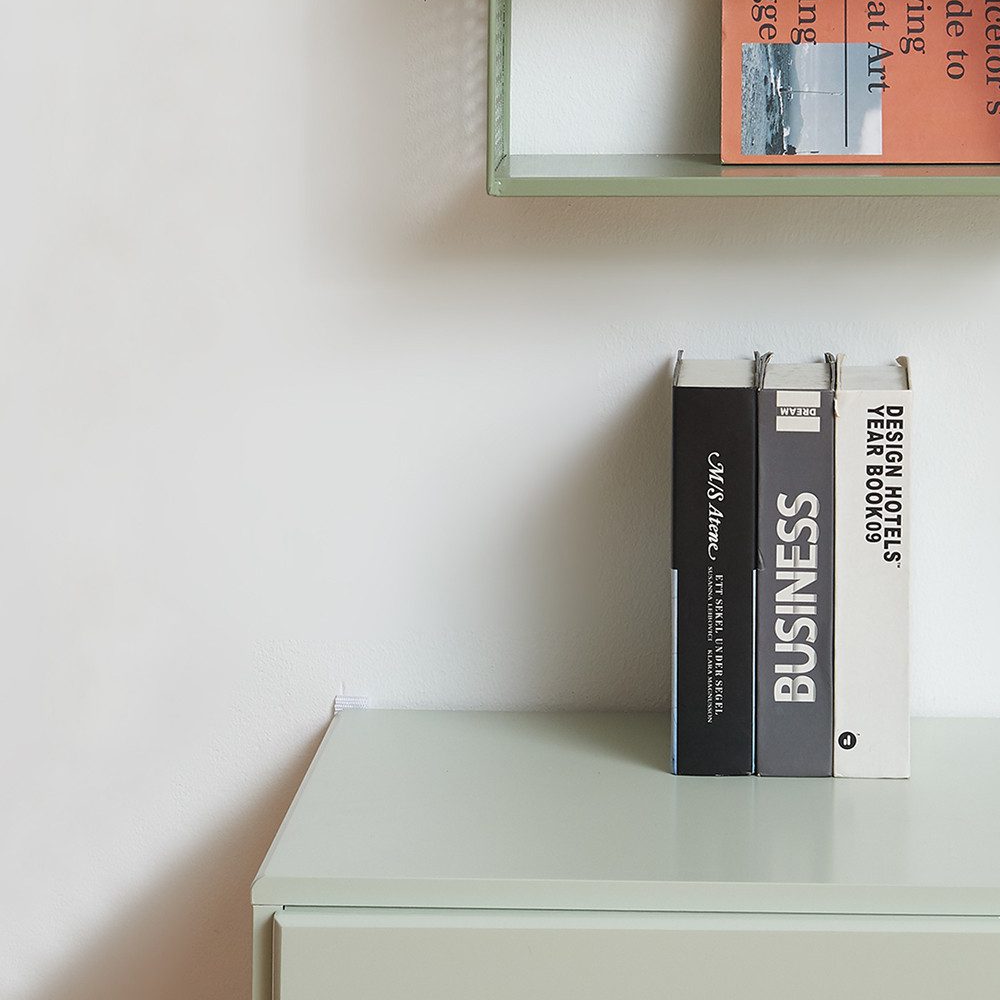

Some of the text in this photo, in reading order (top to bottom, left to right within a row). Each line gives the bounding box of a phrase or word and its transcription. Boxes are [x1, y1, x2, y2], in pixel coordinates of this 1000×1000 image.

[867, 42, 894, 93] Art
[946, 50, 969, 80] to
[780, 407, 817, 416] DREAM
[885, 405, 904, 477] DESIGN
[707, 451, 724, 501] M/S
[865, 405, 885, 543] YEAR BOOK09
[715, 574, 724, 595] ETT
[774, 492, 819, 702] BUSINESS
[715, 598, 724, 634] SEKEL
[715, 680, 724, 716] SEGEL
